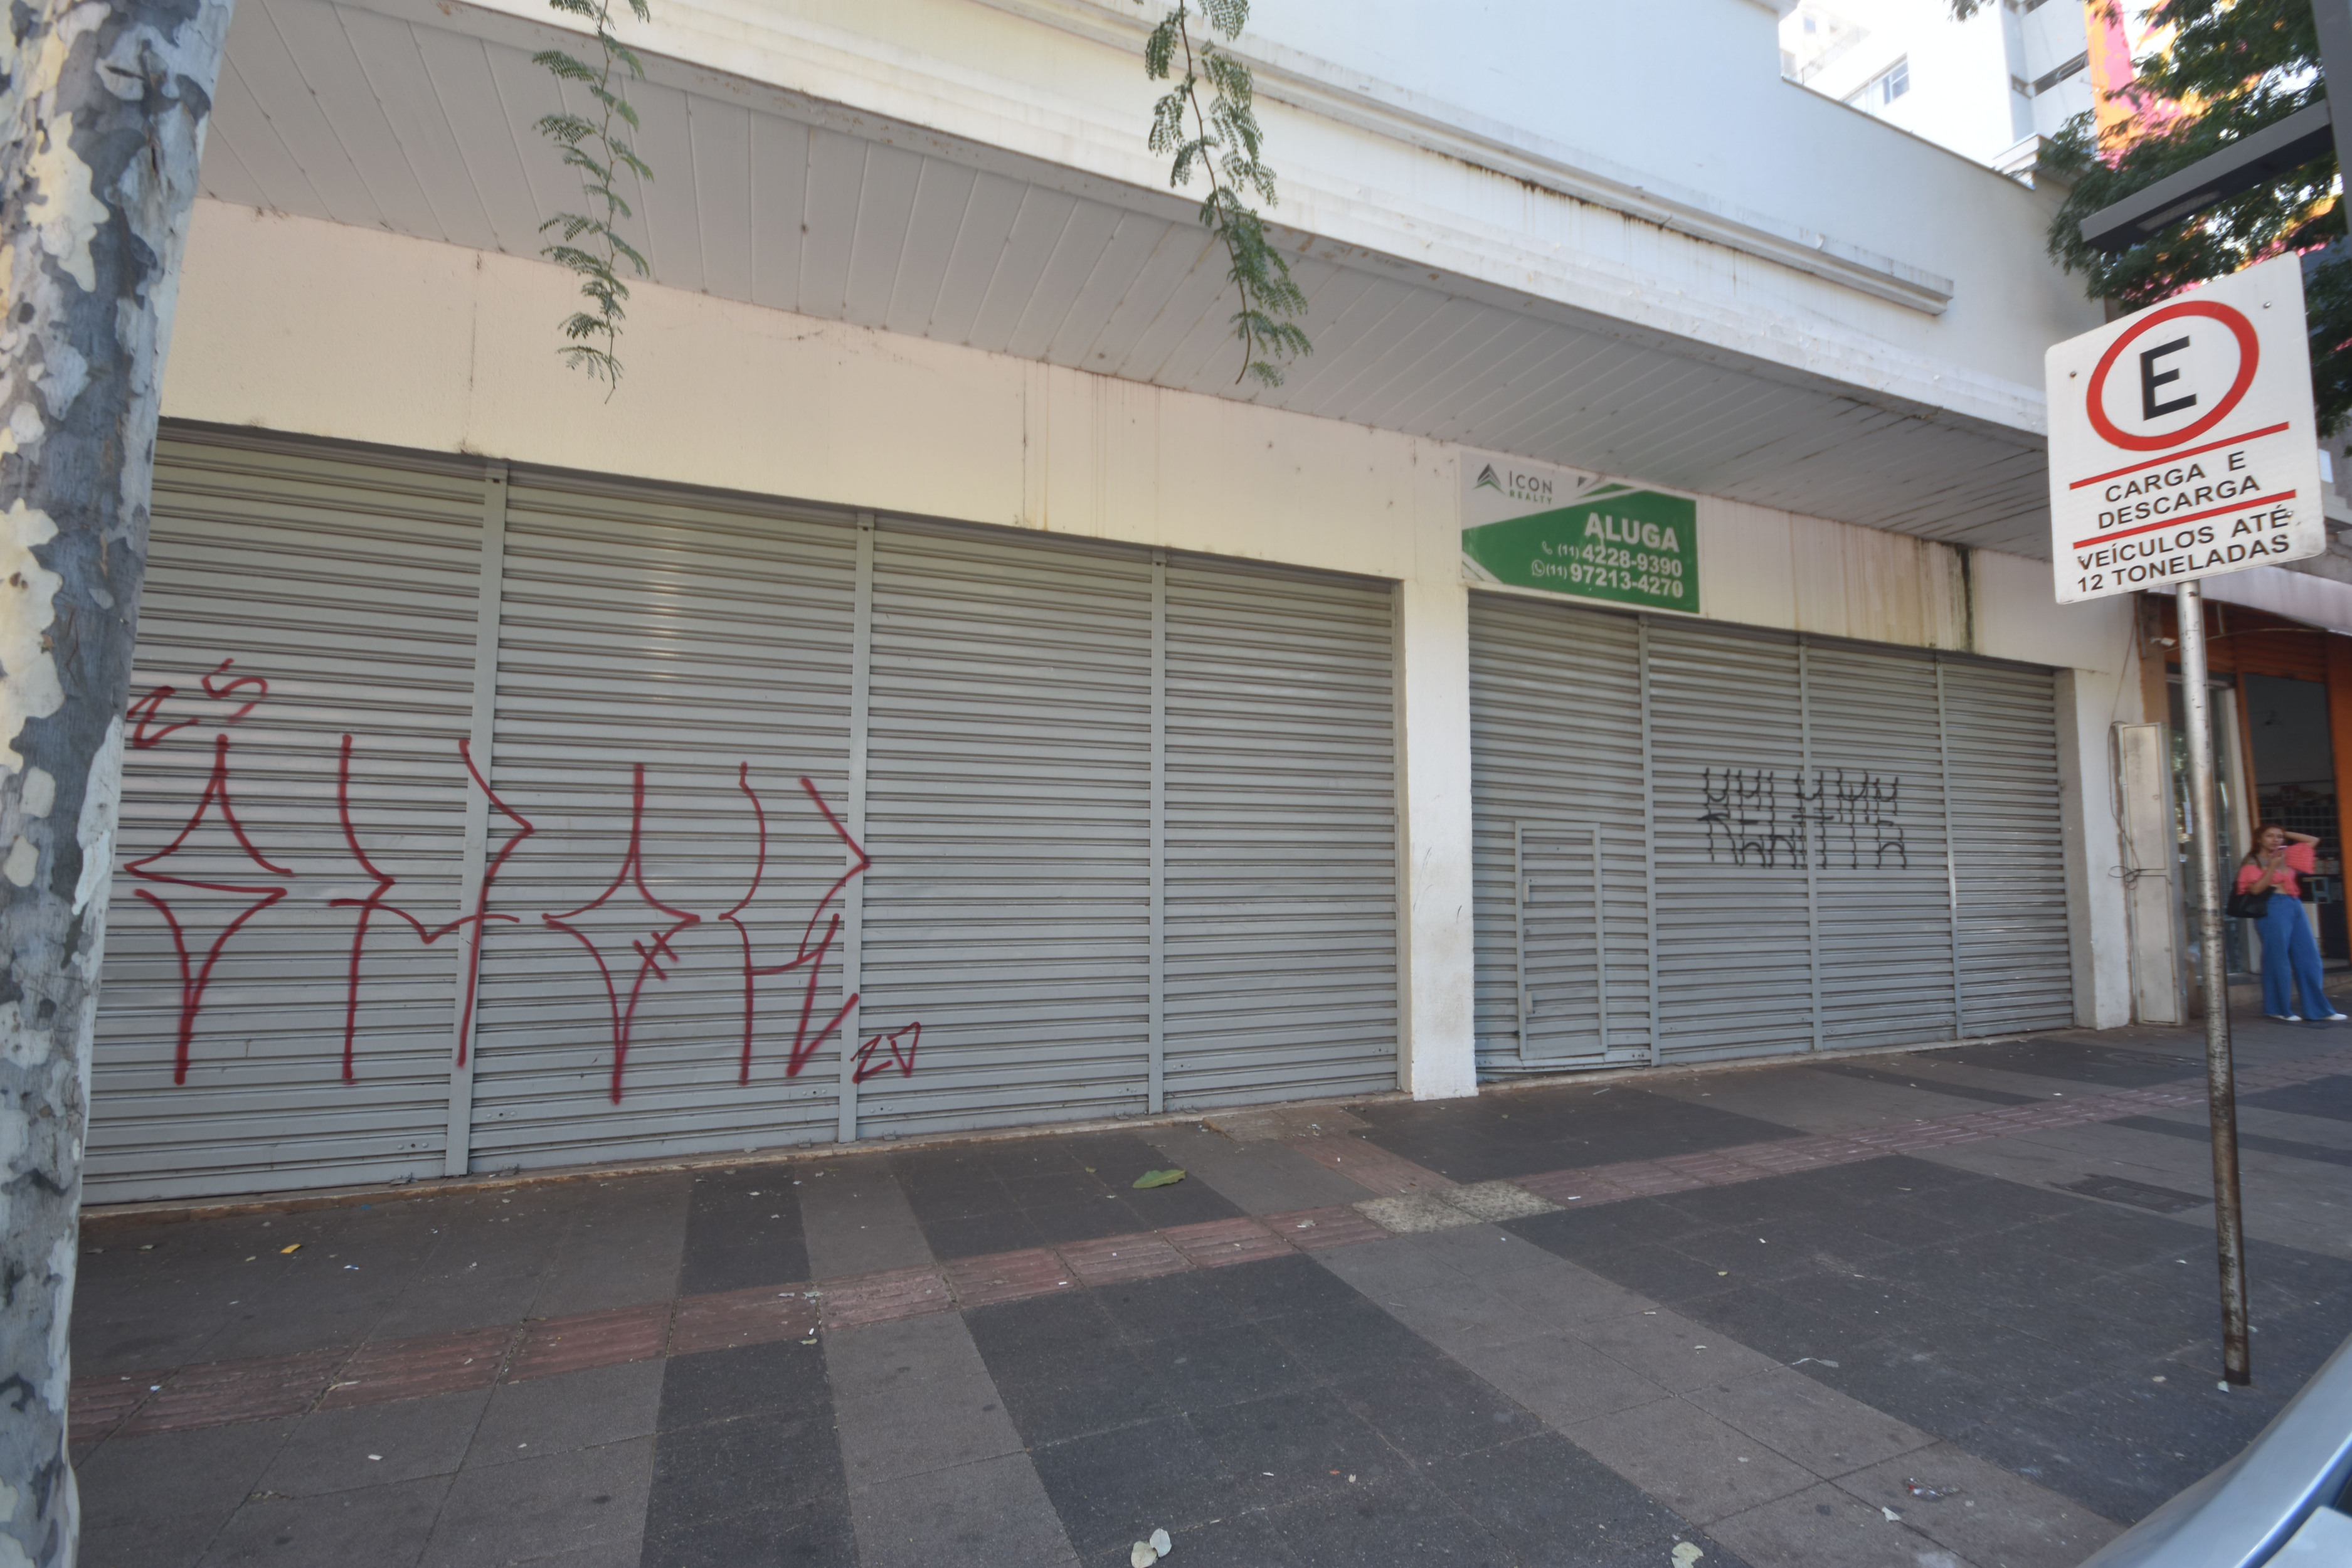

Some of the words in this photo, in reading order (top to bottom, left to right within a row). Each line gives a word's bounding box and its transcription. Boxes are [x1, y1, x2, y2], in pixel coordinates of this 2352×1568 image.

[2139, 335, 2197, 421] E
[1509, 470, 1552, 494] ICON
[1510, 489, 1552, 505] REALTY
[2105, 462, 2206, 502] CARGA
[2228, 451, 2245, 472] E
[2099, 474, 2260, 530] DESCARGA
[1584, 512, 1680, 553] ALUGA
[2077, 526, 2214, 572] VEÍCULOS
[2231, 504, 2289, 538] ATÉ
[1546, 564, 1568, 580] (11)
[1570, 563, 1683, 598] 97213-4270
[1558, 543, 1579, 559] (11)
[1582, 544, 1682, 578] 4228-9390
[2077, 573, 2104, 593] 12
[2111, 533, 2290, 586] TONELADAS
